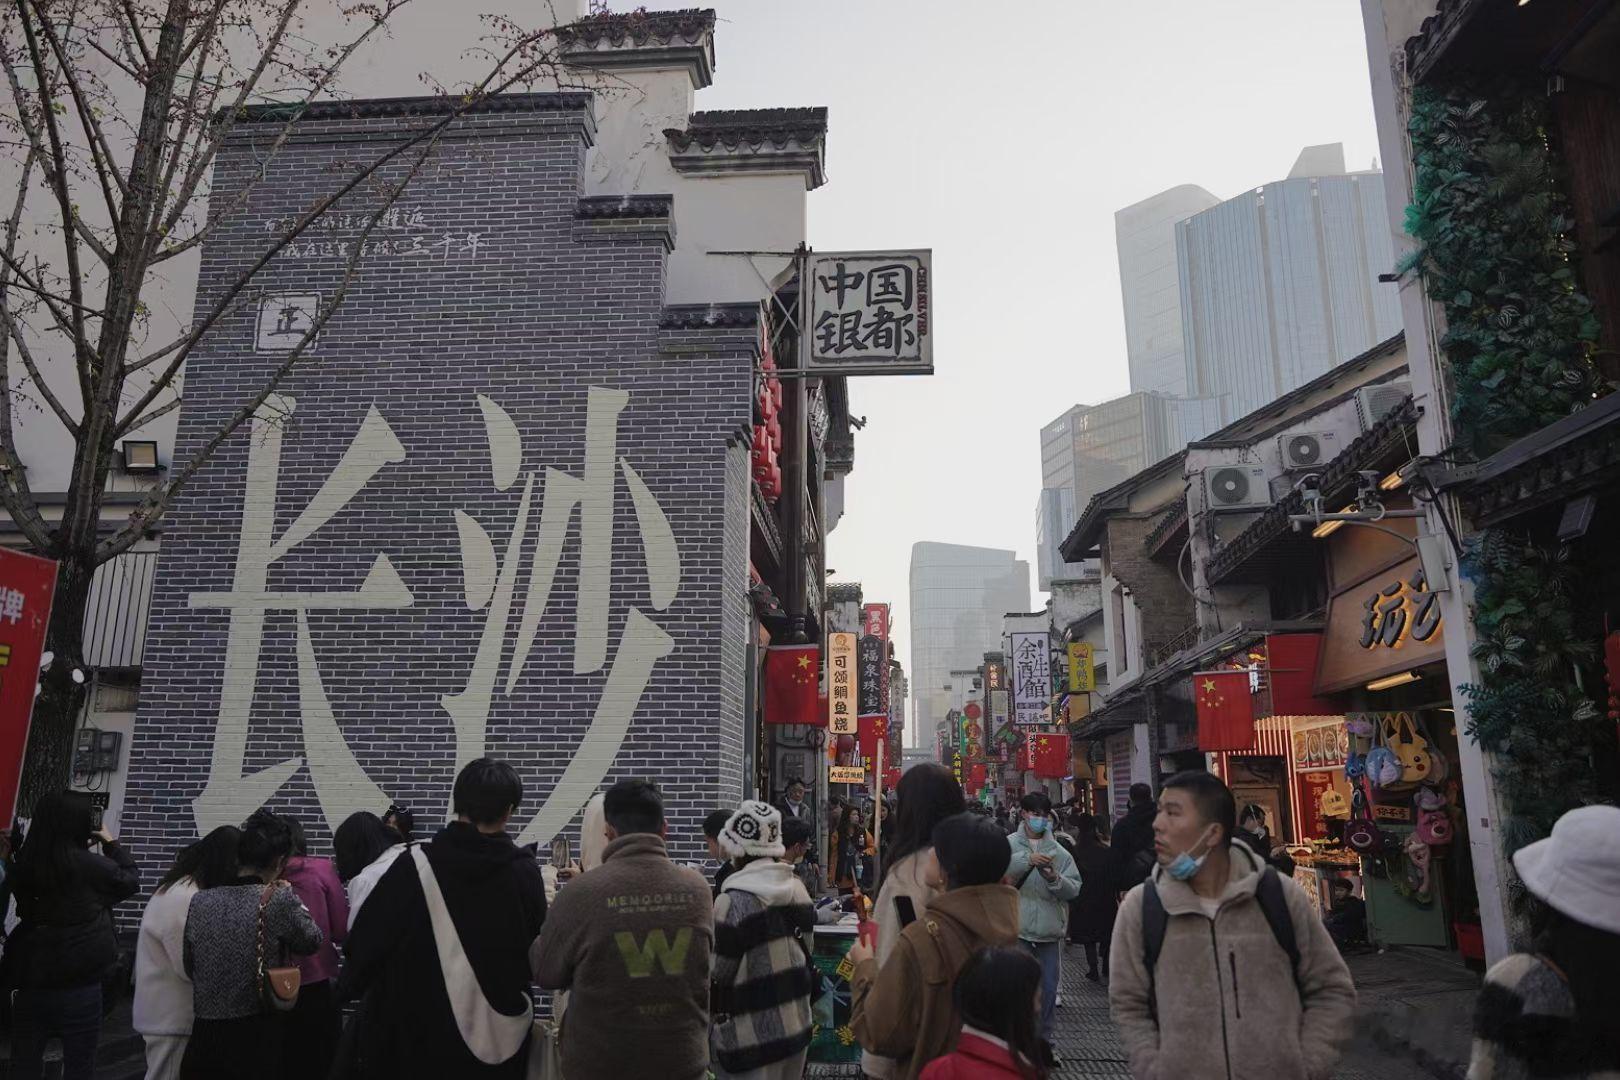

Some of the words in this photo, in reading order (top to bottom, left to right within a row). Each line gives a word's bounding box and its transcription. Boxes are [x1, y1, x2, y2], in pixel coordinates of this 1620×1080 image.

[818, 263, 914, 311] 中国
[267, 305, 308, 338] 正
[815, 305, 916, 355] 银都
[188, 386, 680, 846] 长沙
[613, 926, 694, 979] W
